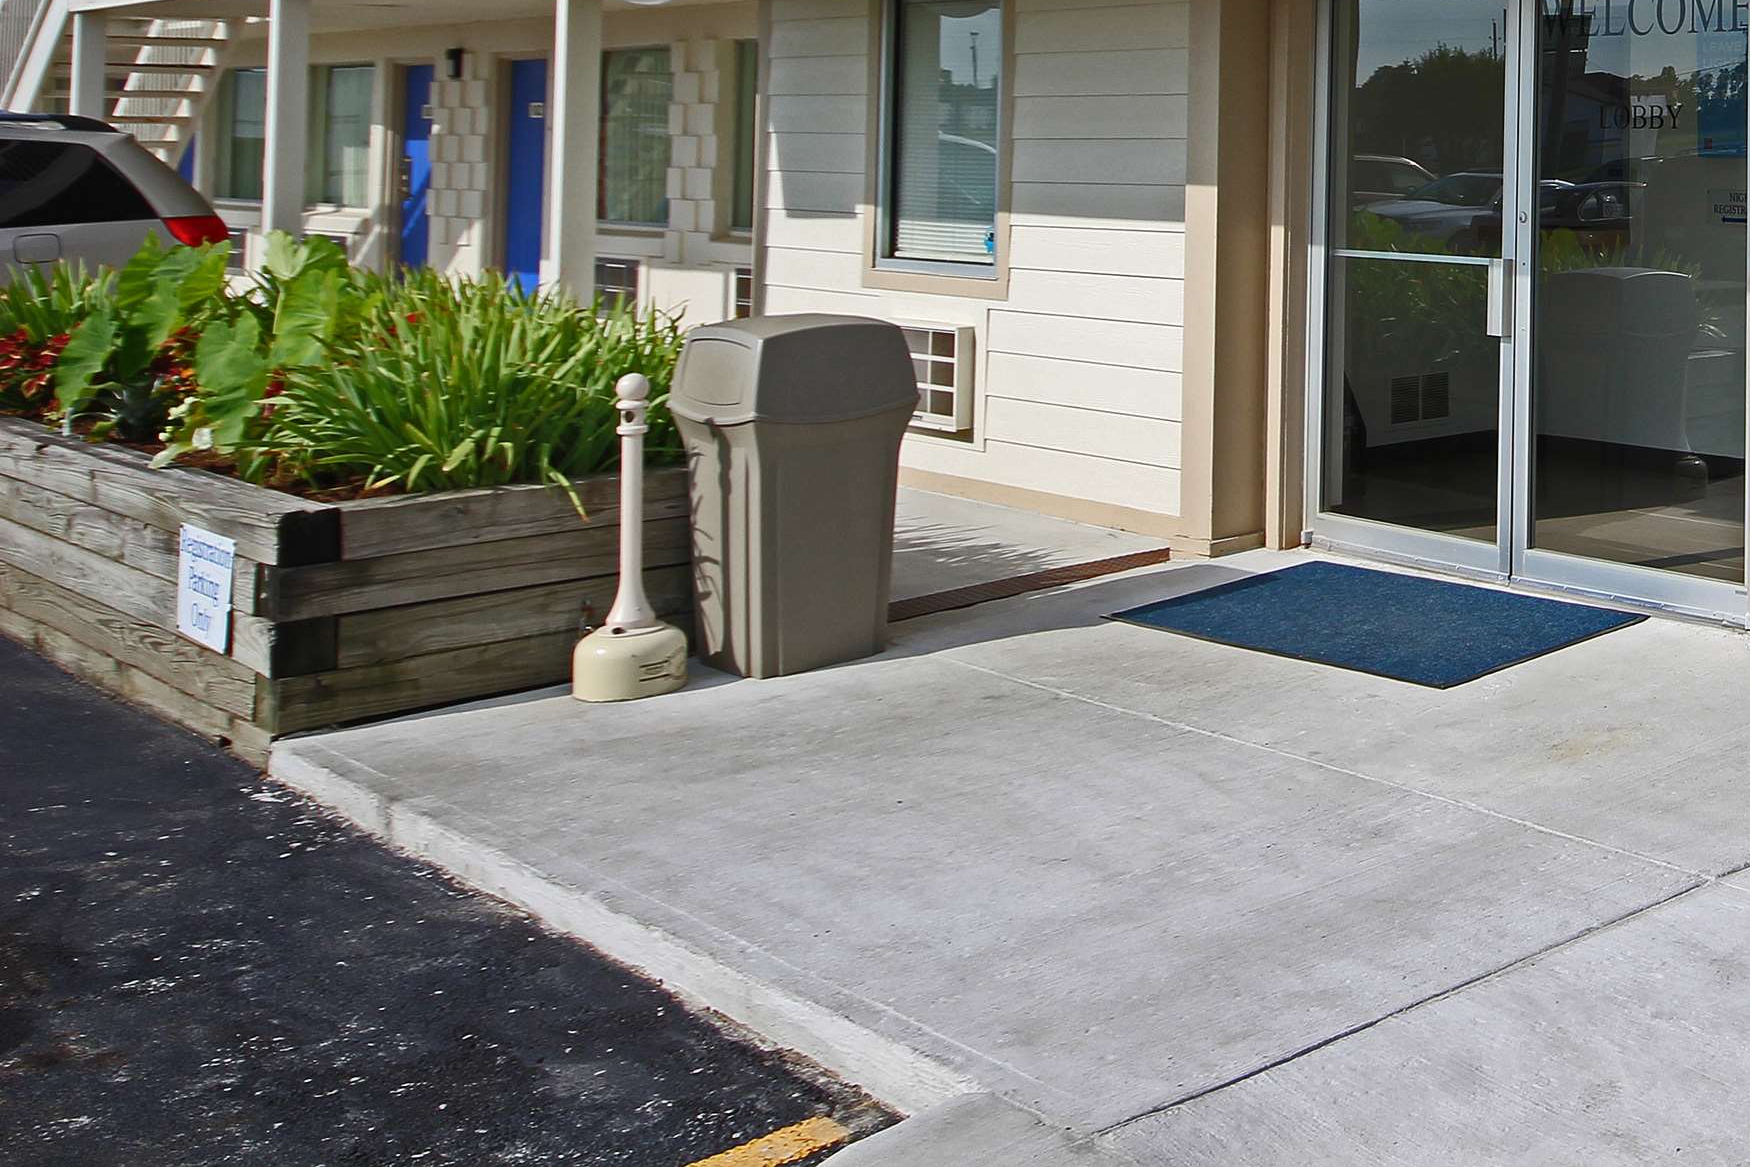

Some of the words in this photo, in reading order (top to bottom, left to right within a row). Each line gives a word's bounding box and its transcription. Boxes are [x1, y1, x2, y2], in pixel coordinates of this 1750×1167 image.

[1600, 105, 1683, 129] LOBBY
[188, 566, 219, 607] Parking
[192, 603, 211, 638] Only
